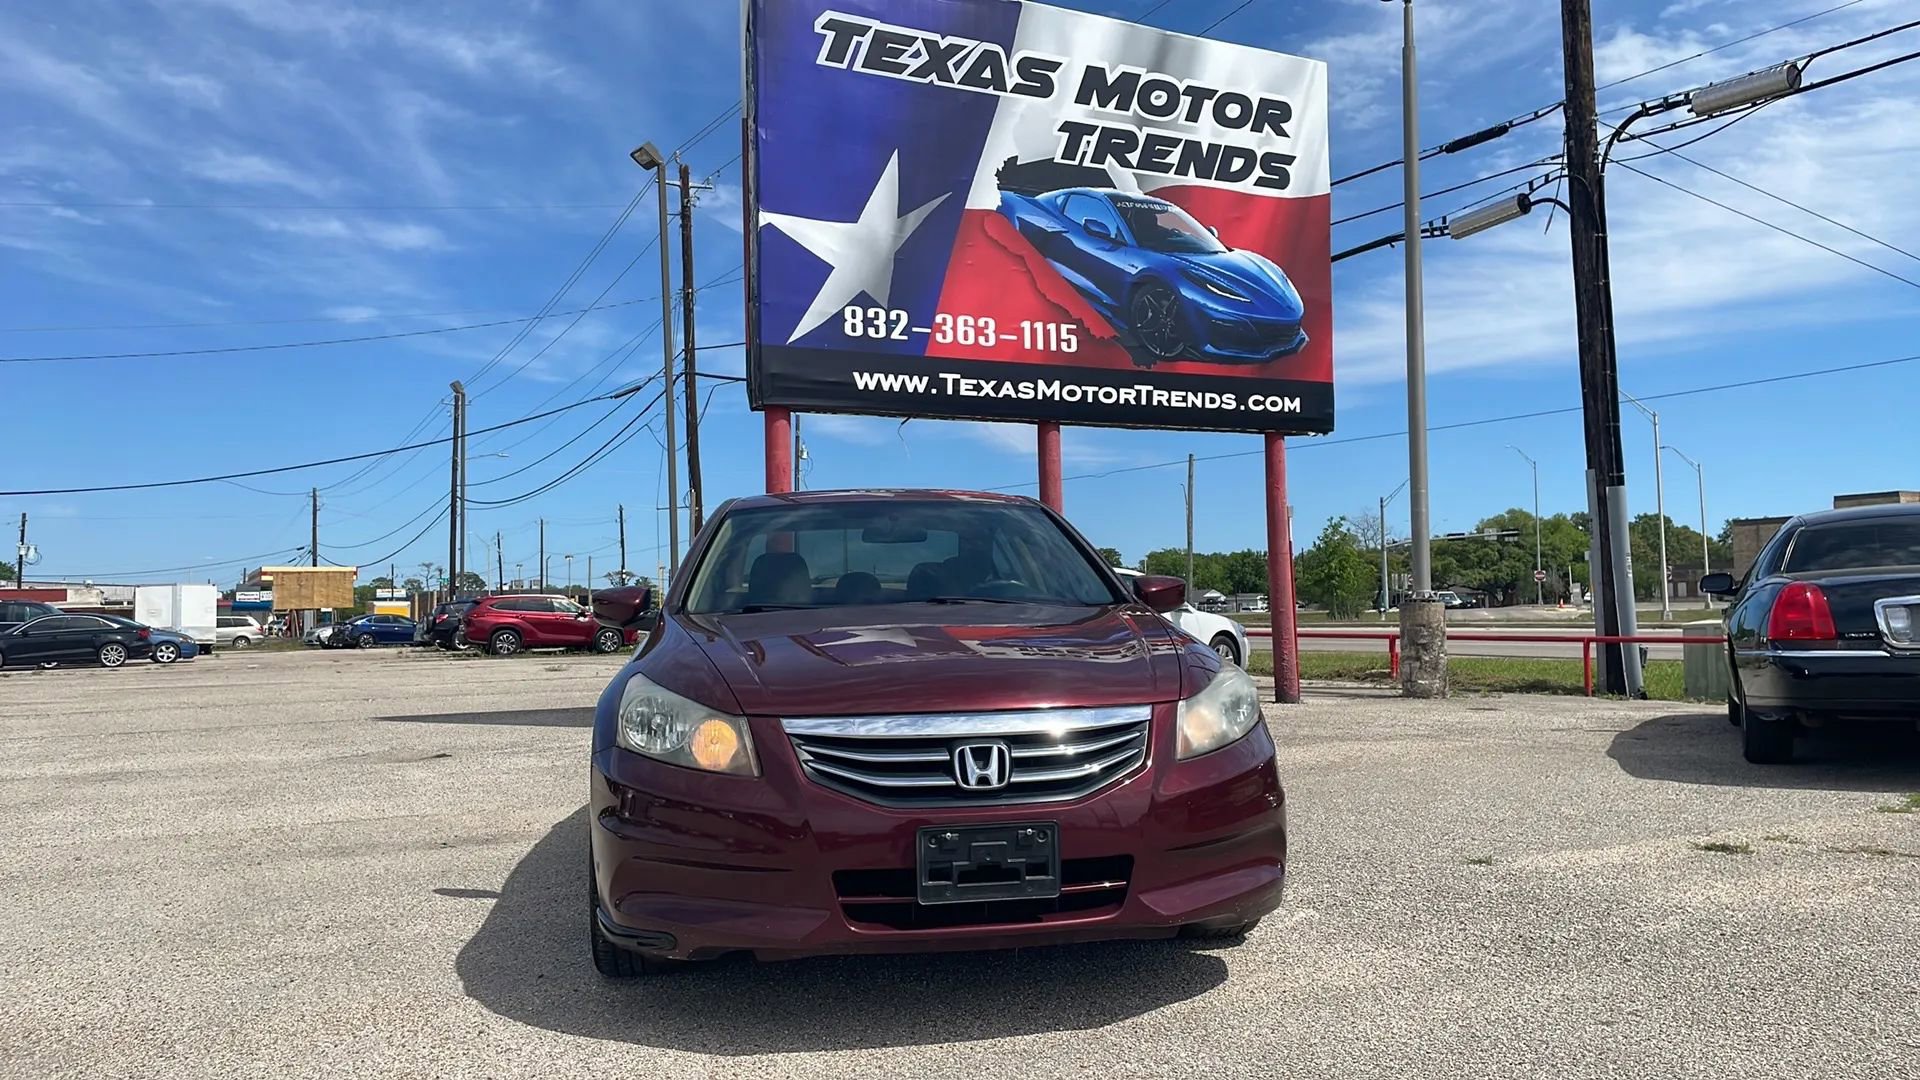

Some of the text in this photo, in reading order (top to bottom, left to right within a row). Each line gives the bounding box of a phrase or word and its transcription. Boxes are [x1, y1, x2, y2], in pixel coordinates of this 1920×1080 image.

[820, 18, 1293, 138] TEXAS MOTOR
[1057, 120, 1297, 190] TRENDS
[843, 305, 1079, 353] 832-363-1115
